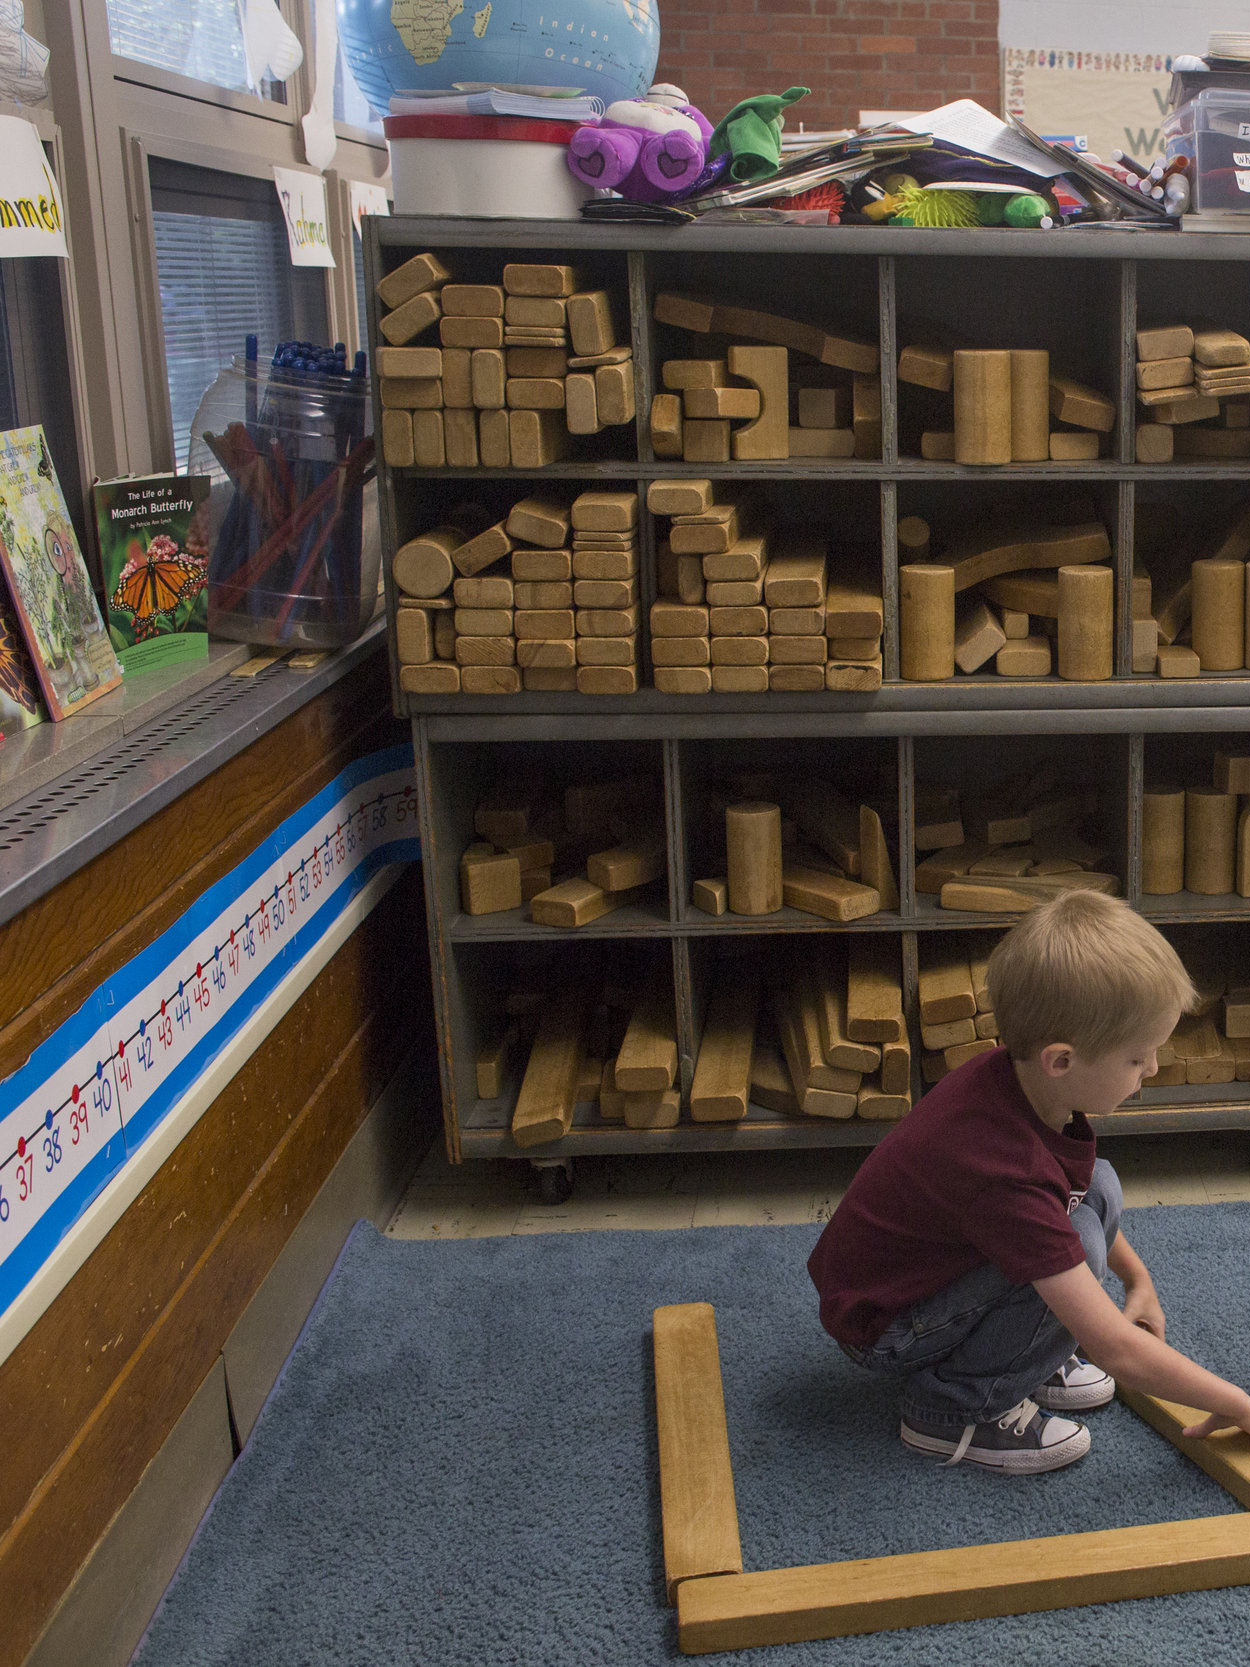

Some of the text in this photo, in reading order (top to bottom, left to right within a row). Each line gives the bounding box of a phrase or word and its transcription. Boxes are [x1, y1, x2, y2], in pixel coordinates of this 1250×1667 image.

[539, 15, 609, 42] Indian
[544, 47, 603, 71] Ocean
[1242, 126, 1249, 136] I
[281, 190, 327, 248] Rahma
[128, 492, 140, 501] The
[142, 490, 155, 499] Life
[157, 488, 165, 496] of
[111, 499, 193, 519] Monarch Butterfly
[16, 1153, 34, 1201] 37
[43, 1126, 62, 1173] 38
[69, 1100, 89, 1145] 39
[93, 1078, 112, 1118] 40
[118, 1057, 133, 1092] 41
[136, 1036, 154, 1072] 42
[158, 1016, 173, 1050] 43
[176, 995, 191, 1031] 44
[194, 977, 210, 1012] 45
[212, 961, 226, 994] 46
[227, 943, 239, 976] 47
[242, 927, 256, 960] 48
[257, 913, 271, 944] 49
[272, 899, 285, 931] 50
[287, 886, 297, 915] 51
[299, 873, 311, 902] 52
[312, 860, 323, 889] 53
[323, 849, 334, 877] 54
[335, 836, 346, 865] 55
[346, 828, 356, 852] 56
[358, 815, 369, 841] 57
[372, 805, 387, 831] 58
[395, 798, 419, 822] 59
